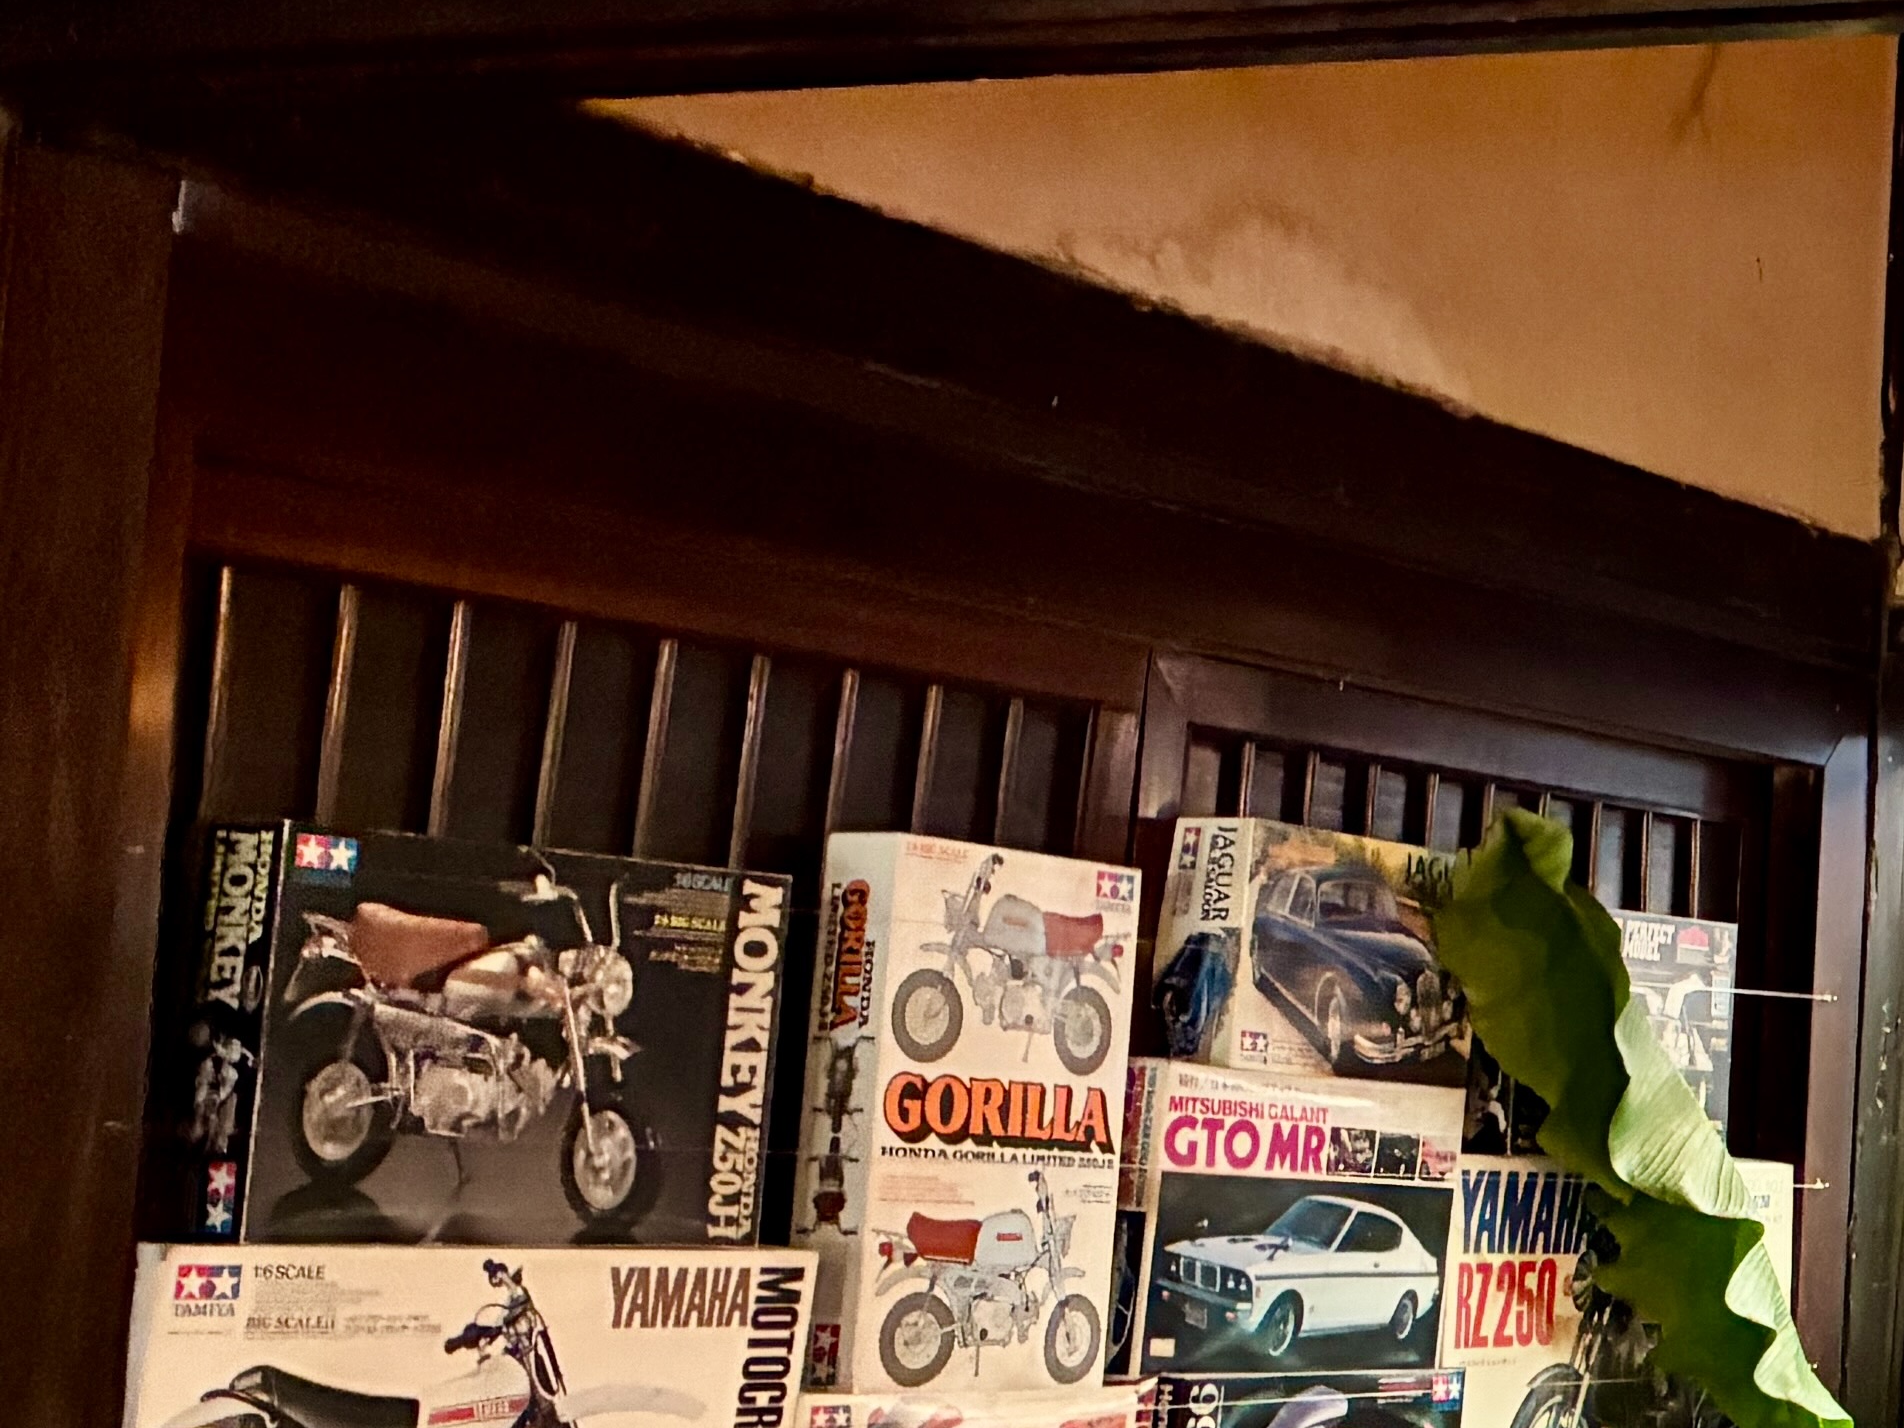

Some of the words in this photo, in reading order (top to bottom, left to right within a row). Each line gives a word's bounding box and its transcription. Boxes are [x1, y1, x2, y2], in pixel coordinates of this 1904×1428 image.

[1212, 825, 1238, 922] JAGUAR
[207, 829, 259, 1011] MONKEY
[829, 878, 871, 1032] GORILLA
[717, 878, 784, 1125] MONKEY
[858, 940, 876, 1029] HONDA
[884, 1071, 1115, 1154] GORILLA
[1164, 1115, 1260, 1170] GTO
[1264, 1122, 1328, 1174] MR
[1169, 1095, 1265, 1120] MITSUBISHI
[1267, 1102, 1329, 1125] GALANT
[880, 1145, 951, 1161] HONDA
[952, 1149, 1019, 1165] GORILLA
[275, 1264, 327, 1280] SCALE
[609, 1266, 752, 1329] YAMAHA
